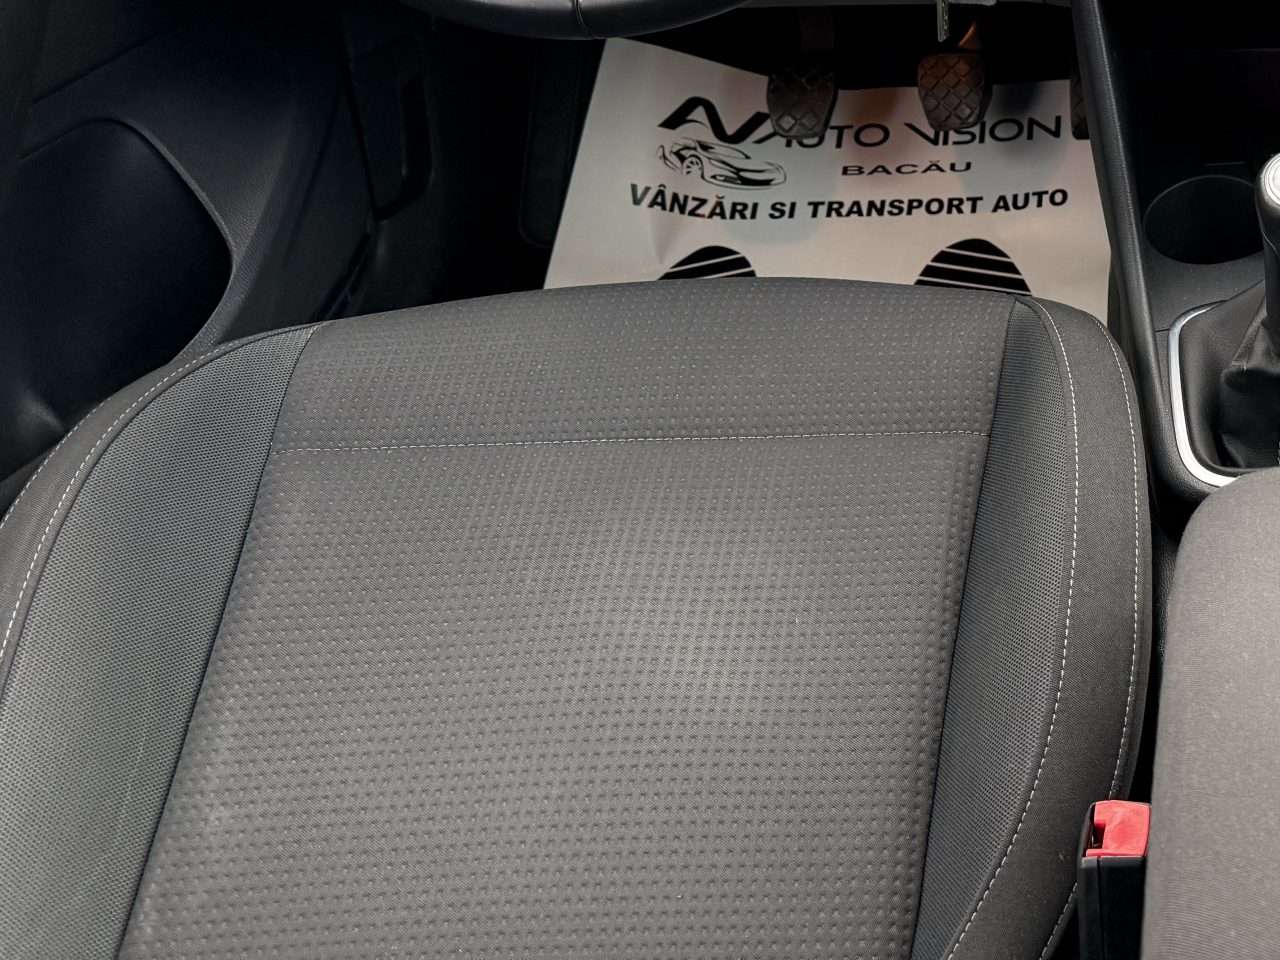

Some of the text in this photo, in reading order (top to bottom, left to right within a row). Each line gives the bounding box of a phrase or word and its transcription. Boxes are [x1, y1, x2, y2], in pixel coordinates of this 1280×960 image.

[904, 116, 1061, 145] VISION
[841, 161, 972, 177] BACĂU
[629, 183, 1069, 221] VÂNZĂRI SI TRANSPORT AUTO
